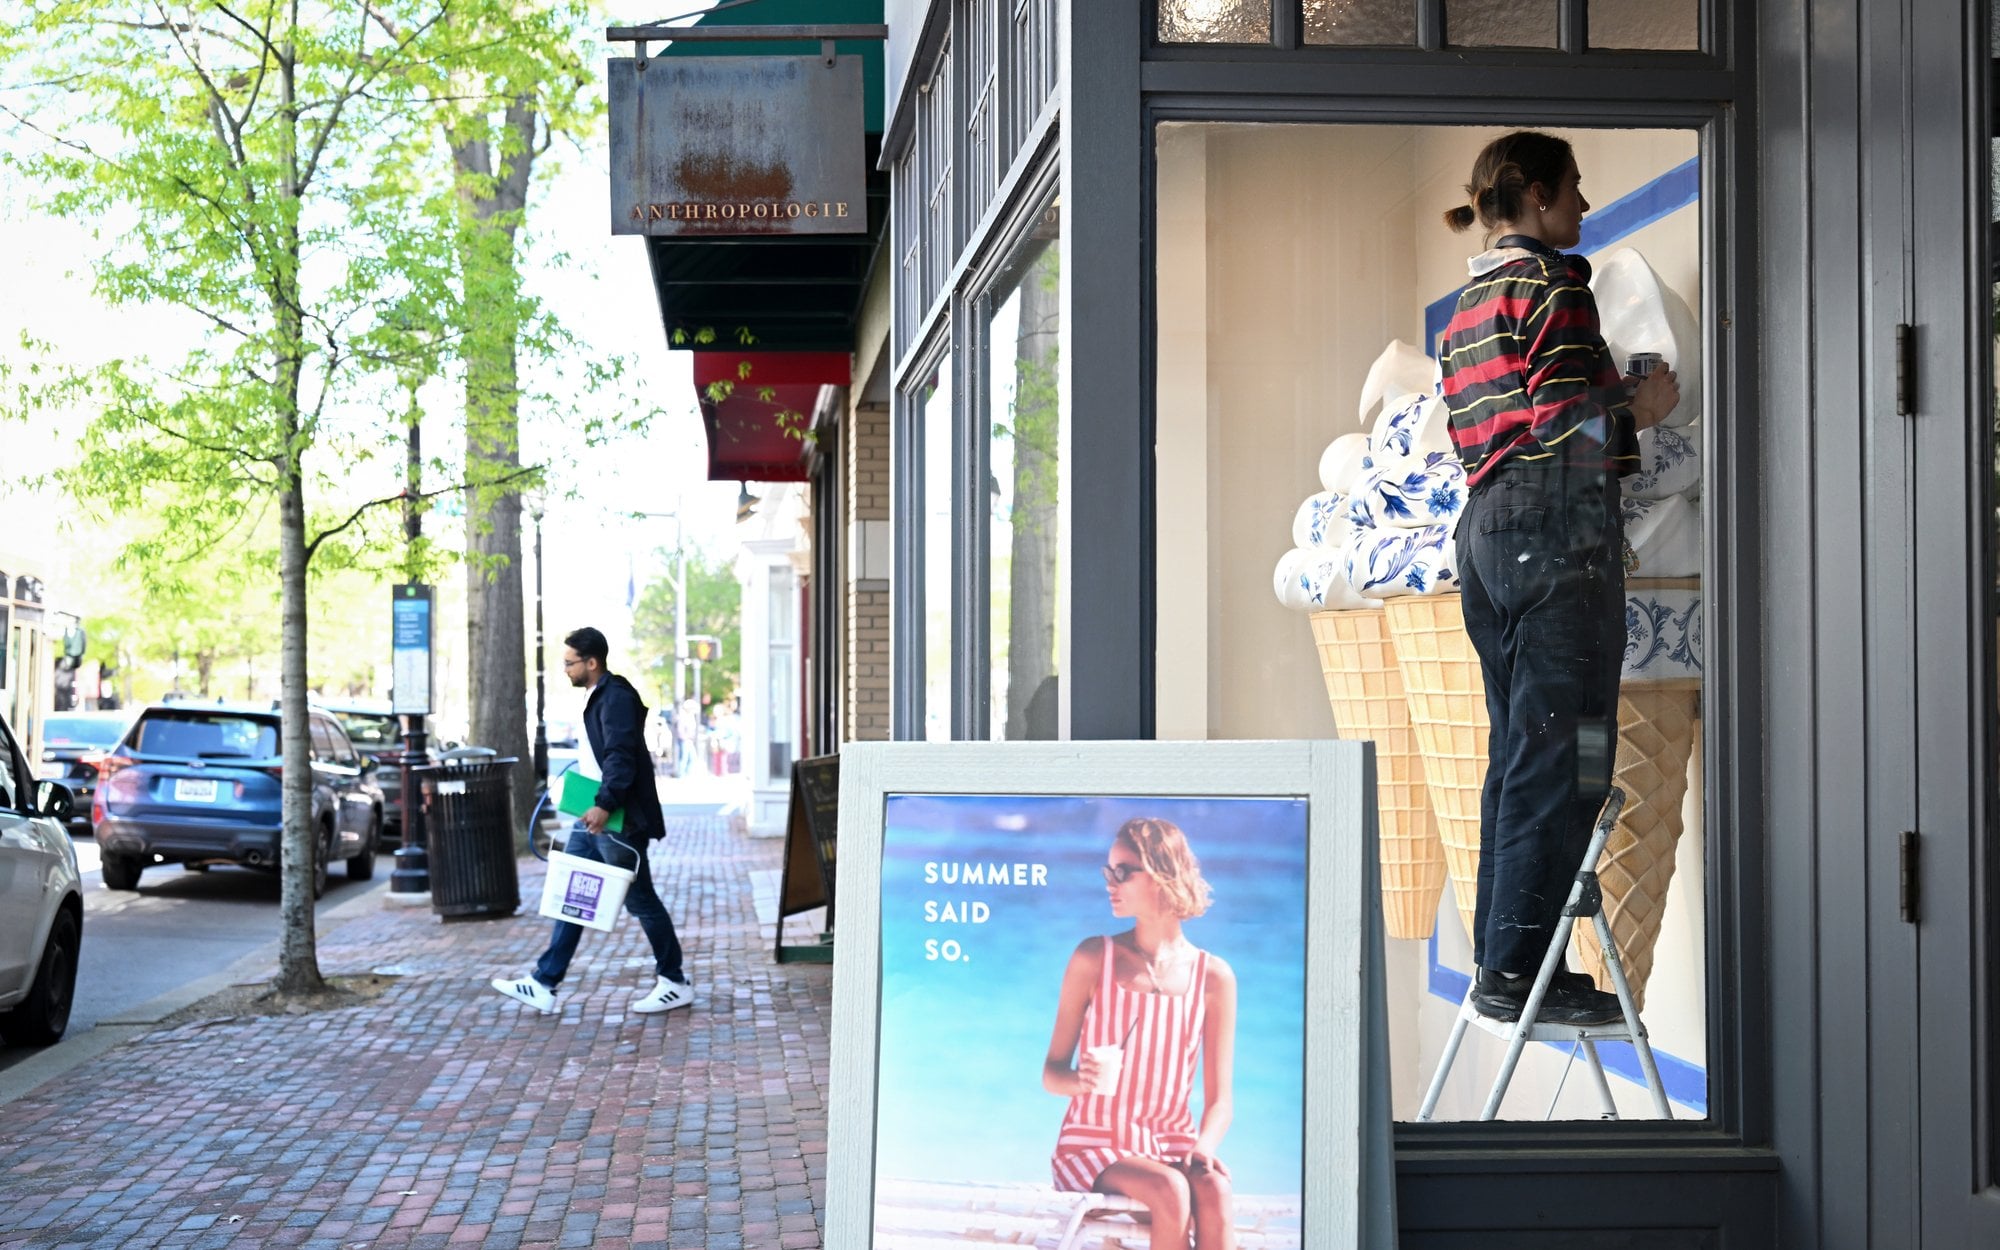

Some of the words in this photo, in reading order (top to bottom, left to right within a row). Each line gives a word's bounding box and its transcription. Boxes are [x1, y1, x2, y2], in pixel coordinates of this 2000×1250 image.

[631, 202, 849, 220] ANTHROPOLOGIE
[924, 862, 1048, 886] SUMMER
[924, 900, 990, 923] SAID
[924, 938, 970, 962] SO.
